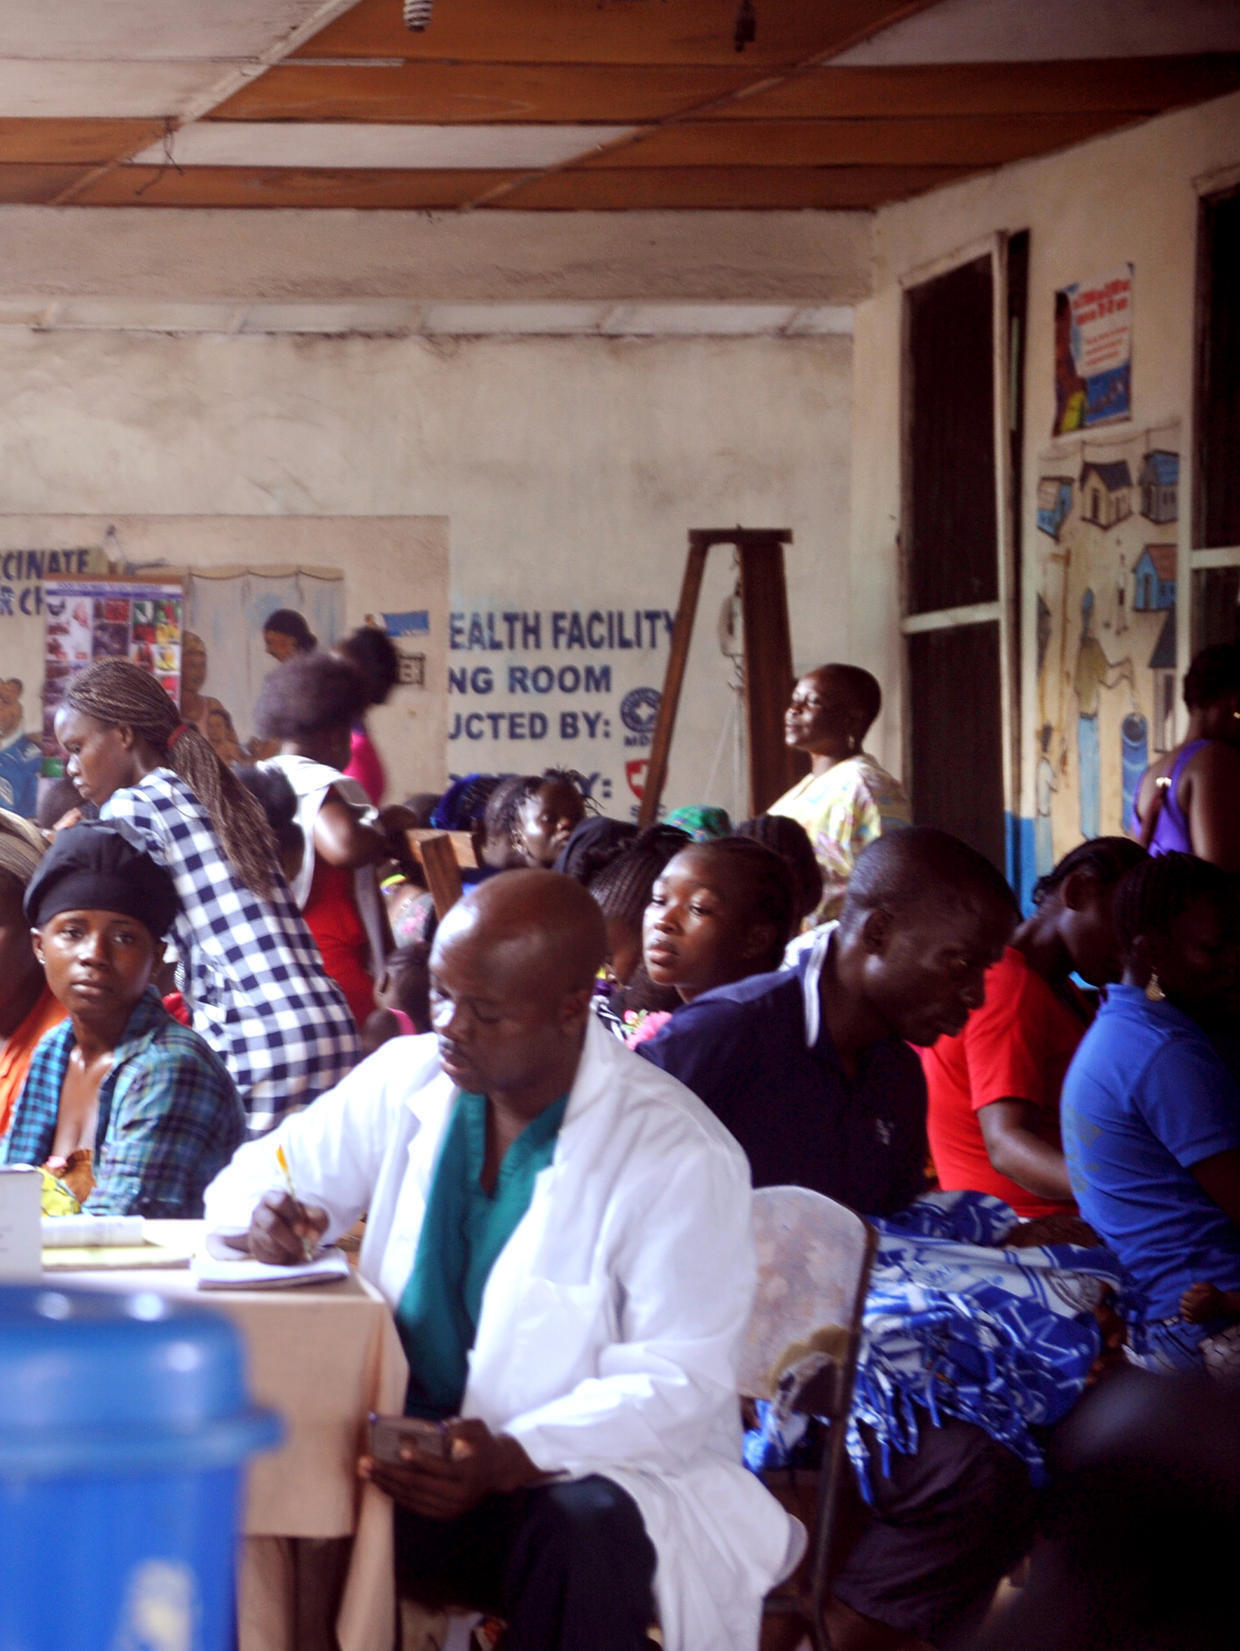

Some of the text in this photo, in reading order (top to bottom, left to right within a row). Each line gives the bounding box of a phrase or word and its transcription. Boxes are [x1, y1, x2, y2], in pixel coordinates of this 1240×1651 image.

[448, 666, 494, 694] NG
[508, 664, 612, 694] ROOM
[560, 711, 611, 740] BY:
